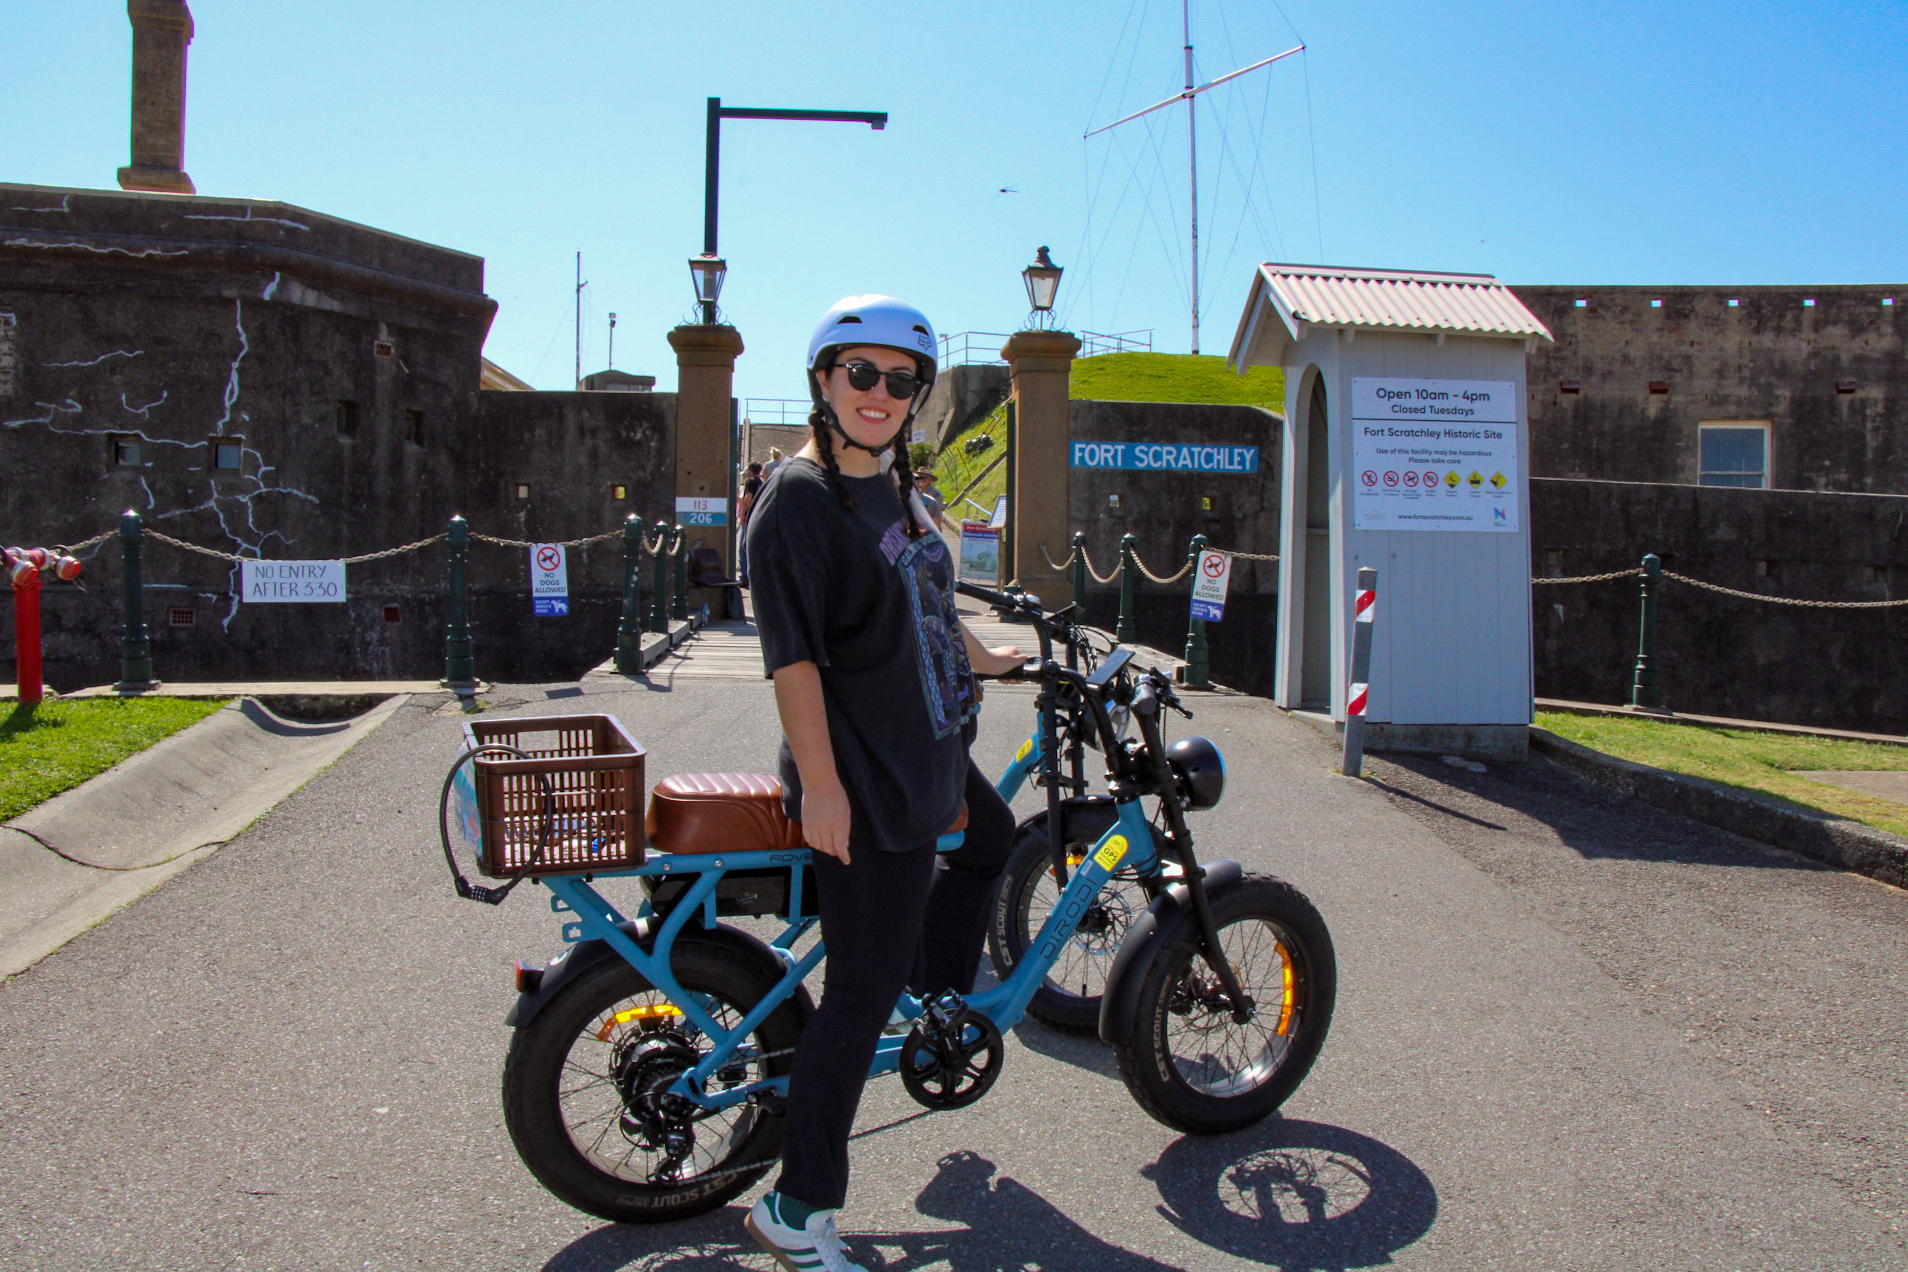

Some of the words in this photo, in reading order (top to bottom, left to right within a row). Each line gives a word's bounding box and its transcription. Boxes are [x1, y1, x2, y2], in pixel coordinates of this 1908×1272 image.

[1376, 388, 1412, 402] Open
[1414, 389, 1449, 400] 10am
[1462, 390, 1490, 404] 4pm
[1391, 404, 1426, 414] Closed
[1428, 406, 1474, 417] Tuesdays
[1364, 427, 1385, 436] Fort
[1388, 428, 1441, 440] Scratchley
[1444, 429, 1481, 439] Historic
[1484, 430, 1502, 440] Site
[1074, 444, 1126, 467] FORT
[1134, 446, 1255, 470] SCRATCHLEY
[694, 500, 708, 510] 113
[690, 513, 712, 524] 206
[255, 566, 274, 578] NO
[280, 565, 327, 579] ENTRY
[253, 582, 299, 597] AFTER
[1195, 591, 1224, 600] ALLOWED
[1201, 584, 1220, 592] DOGS
[1104, 847, 1118, 862] GPS
[997, 900, 1006, 936] SCOUT
[1040, 878, 1096, 960] DIRODI
[998, 938, 1013, 966] CST
[1154, 1006, 1163, 1049] SCOUT
[1155, 1051, 1170, 1082] CST
[702, 1172, 738, 1196] CST
[651, 1188, 699, 1208] SCOUT
